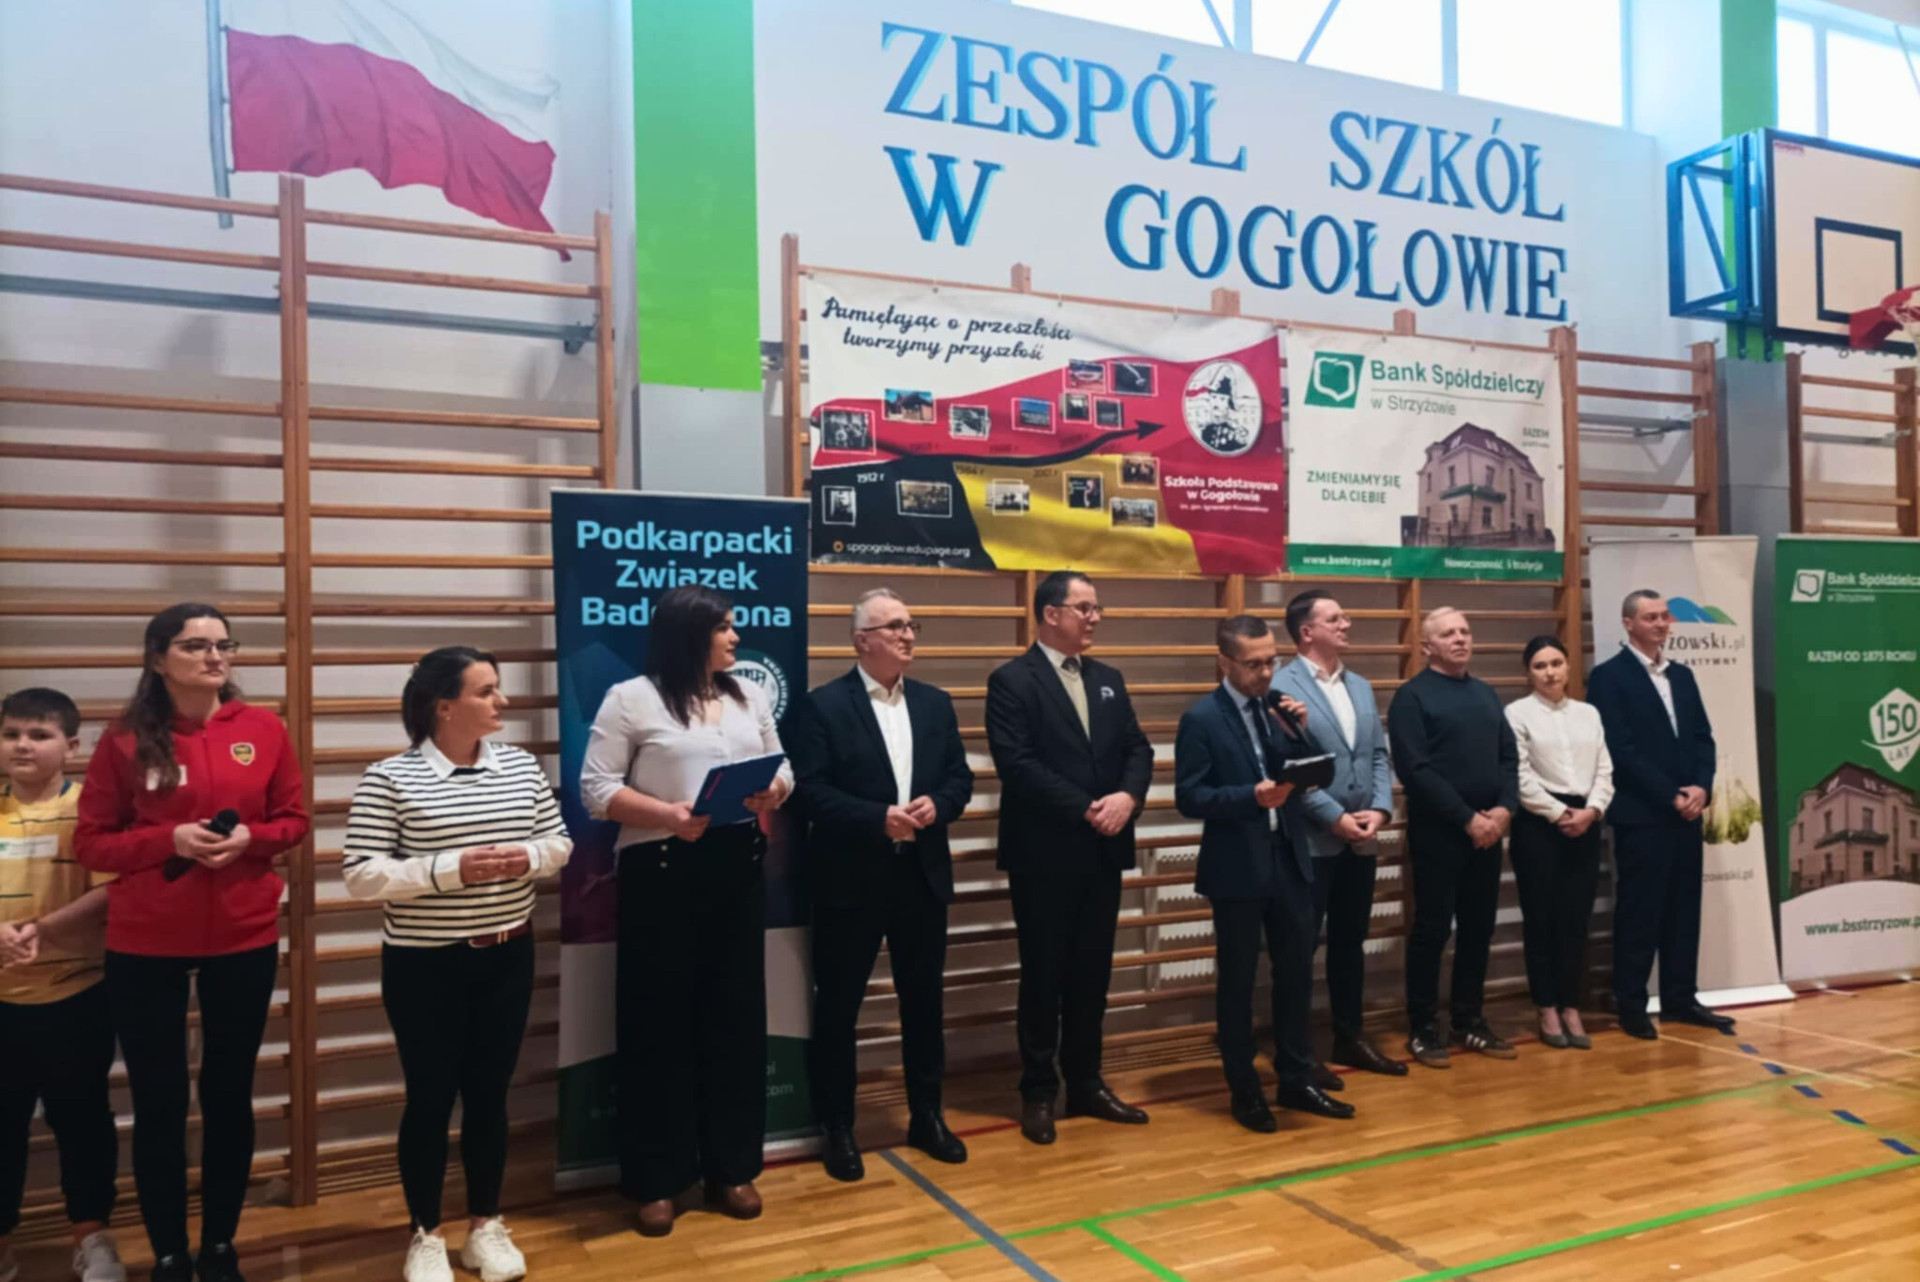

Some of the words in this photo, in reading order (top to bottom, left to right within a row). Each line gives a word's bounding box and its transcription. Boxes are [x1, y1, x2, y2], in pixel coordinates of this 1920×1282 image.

[881, 21, 1246, 171] ZESPÓŁ
[1328, 108, 1566, 222] SZKÓŁ
[883, 146, 1003, 247] W
[1104, 184, 1567, 321] GOGOŁOWIE
[821, 297, 940, 334] Pamiętając
[947, 317, 960, 330] o
[964, 317, 1073, 341] przeszłości
[843, 327, 943, 359] tworzymy
[944, 342, 1044, 363] przyszłość
[1370, 359, 1427, 381] Bank
[1432, 363, 1545, 400] Spółdzielczy
[1371, 398, 1382, 408] w
[1387, 395, 1456, 416] Strzyżowie
[1165, 475, 1205, 488] Szkoła
[1208, 477, 1279, 491] Podstawowa
[1306, 470, 1381, 485] ZMIENIAMY
[1382, 475, 1401, 489] SIĘ
[1186, 490, 1198, 500] w
[1200, 489, 1260, 503] Gogołowie
[1321, 488, 1347, 501] DLA
[1349, 490, 1387, 504] CIEBIE
[576, 520, 792, 558] Podkarpacki
[1827, 571, 1856, 586] Bank
[581, 596, 792, 628] Badona
[1808, 650, 1842, 662] RAZEM
[1843, 650, 1860, 662] OD
[1885, 650, 1917, 662] ROKU
[1876, 703, 1917, 740] 150
[1888, 745, 1910, 761] LAT
